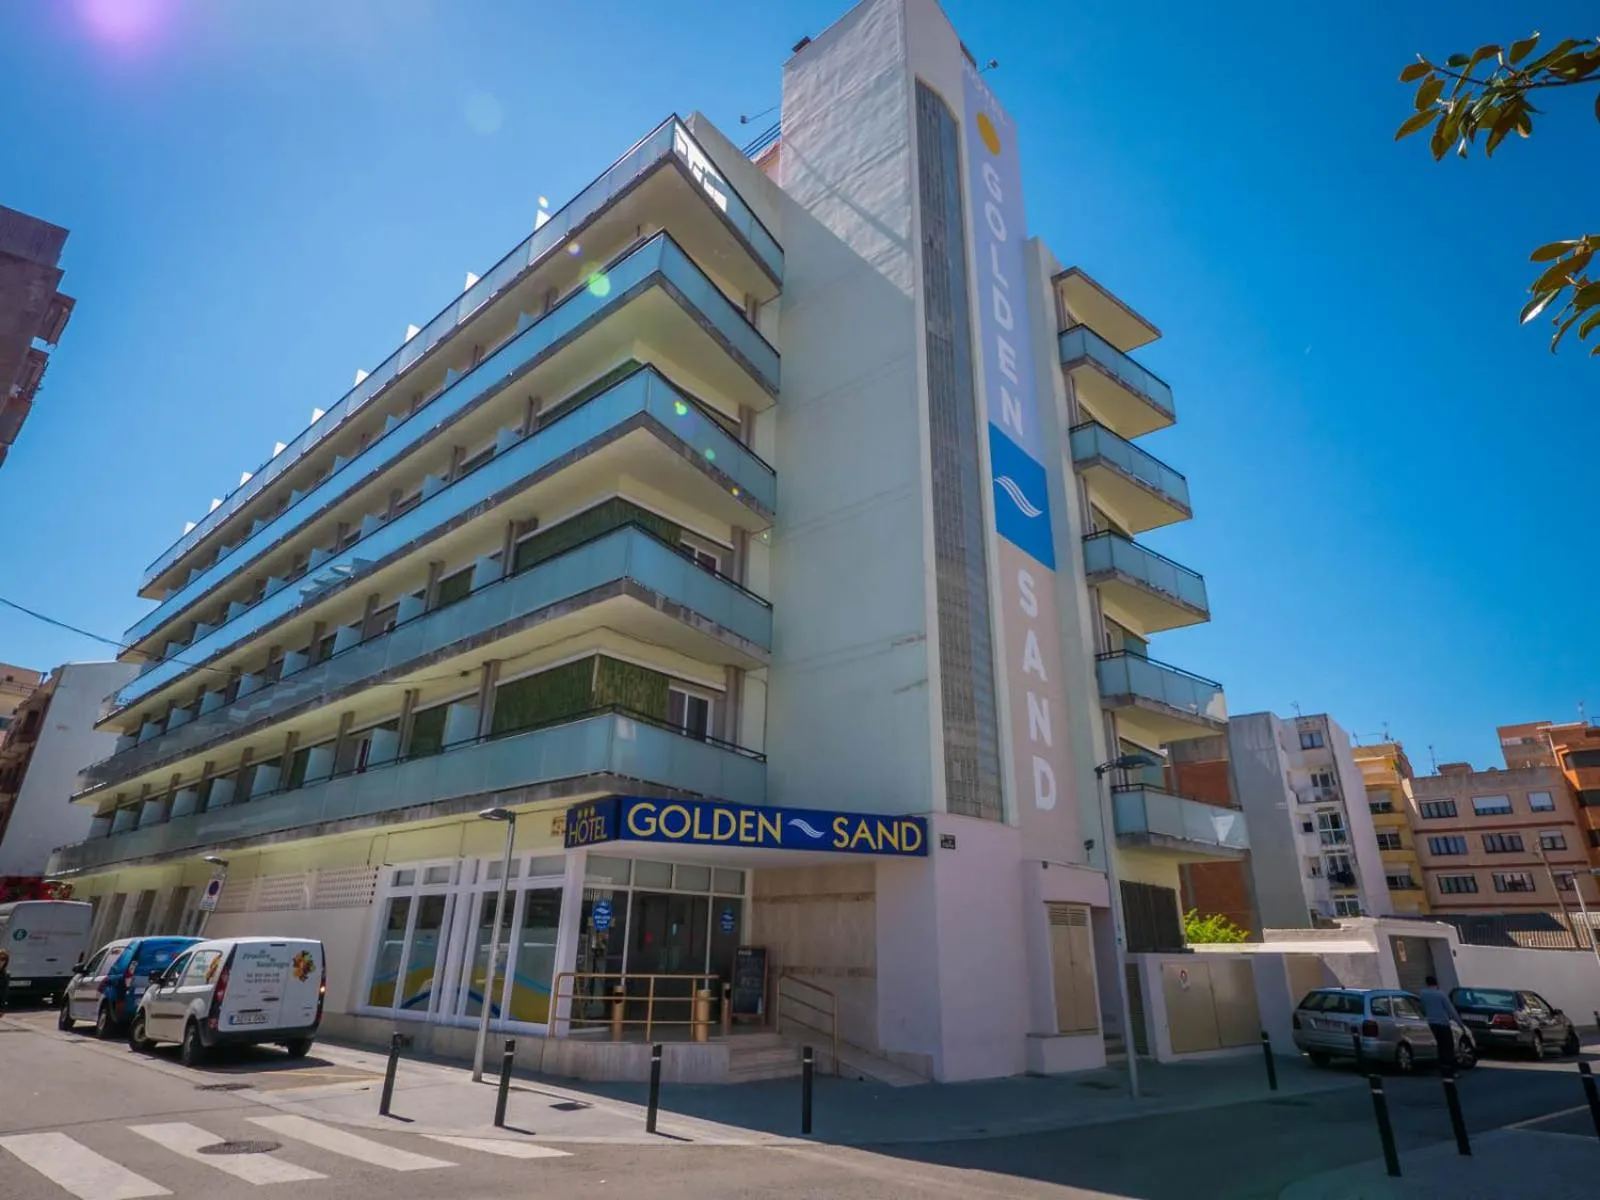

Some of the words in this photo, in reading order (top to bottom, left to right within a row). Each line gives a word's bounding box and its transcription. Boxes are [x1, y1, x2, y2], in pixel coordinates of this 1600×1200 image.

[982, 162, 1024, 436] GOLDEN
[1018, 569, 1057, 811] SAND
[567, 815, 608, 845] HOTEL
[627, 802, 782, 844] GOLDEN
[832, 816, 922, 852] SAND
